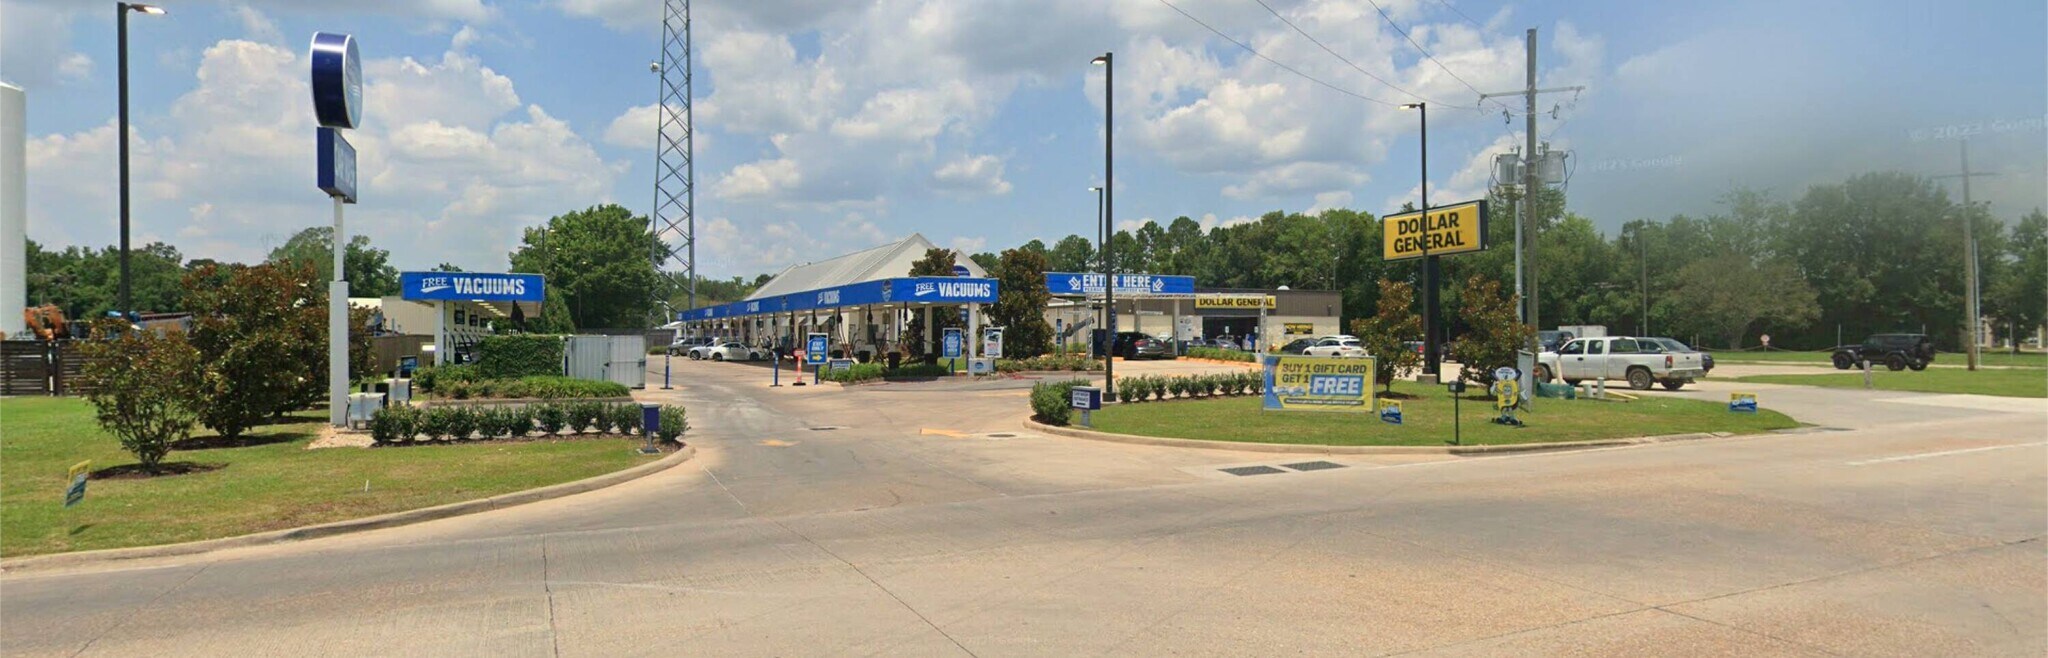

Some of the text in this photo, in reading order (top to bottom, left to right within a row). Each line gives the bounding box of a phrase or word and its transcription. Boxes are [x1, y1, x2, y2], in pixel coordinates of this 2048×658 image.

[421, 277, 525, 295] FREE VACUUMS
[1123, 276, 1151, 288] HERE
[915, 282, 990, 297] FREE VACUUMS
[1199, 298, 1233, 306] DOLLAR
[1282, 363, 1367, 374] BUY 1 GIFT CARD
[1282, 374, 1361, 394] GET 1 FREE
